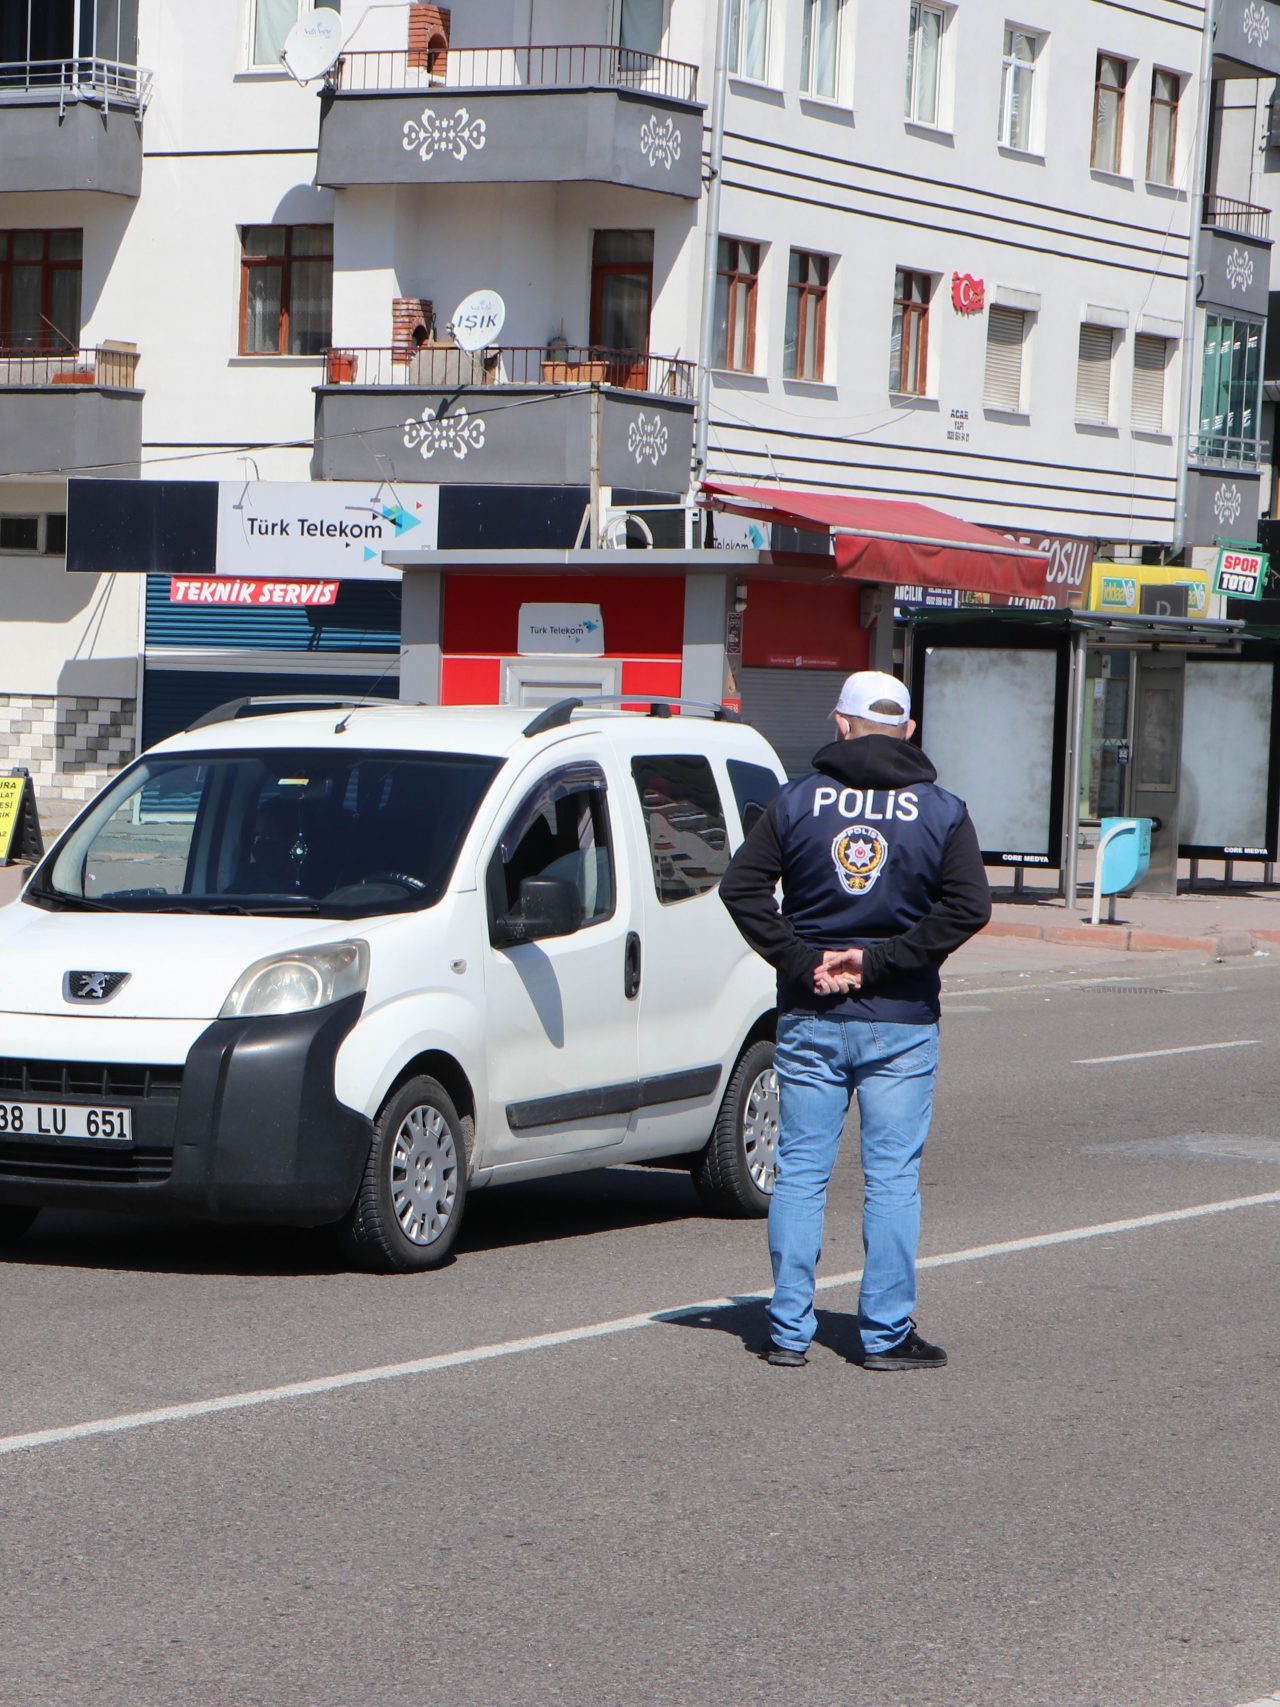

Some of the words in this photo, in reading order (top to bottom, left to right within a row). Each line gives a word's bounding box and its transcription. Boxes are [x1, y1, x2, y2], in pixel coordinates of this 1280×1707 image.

[457, 313, 498, 333] IŞIK
[247, 517, 290, 537] Türk
[298, 519, 382, 539] Telekom
[1224, 556, 1259, 573] SPOR
[175, 579, 252, 604] TEKNİK
[259, 580, 335, 604] SERVİS
[1222, 573, 1255, 592] TOTO
[530, 626, 547, 634] Türk
[550, 626, 584, 634] Telekom
[813, 787, 919, 822] POLİS
[1002, 854, 1022, 862] CORE
[1023, 855, 1049, 863] MEDYA
[1224, 846, 1244, 854] CORE
[1245, 847, 1268, 855] MEDYA
[37, 1107, 66, 1134] LU
[86, 1110, 127, 1138] 651
